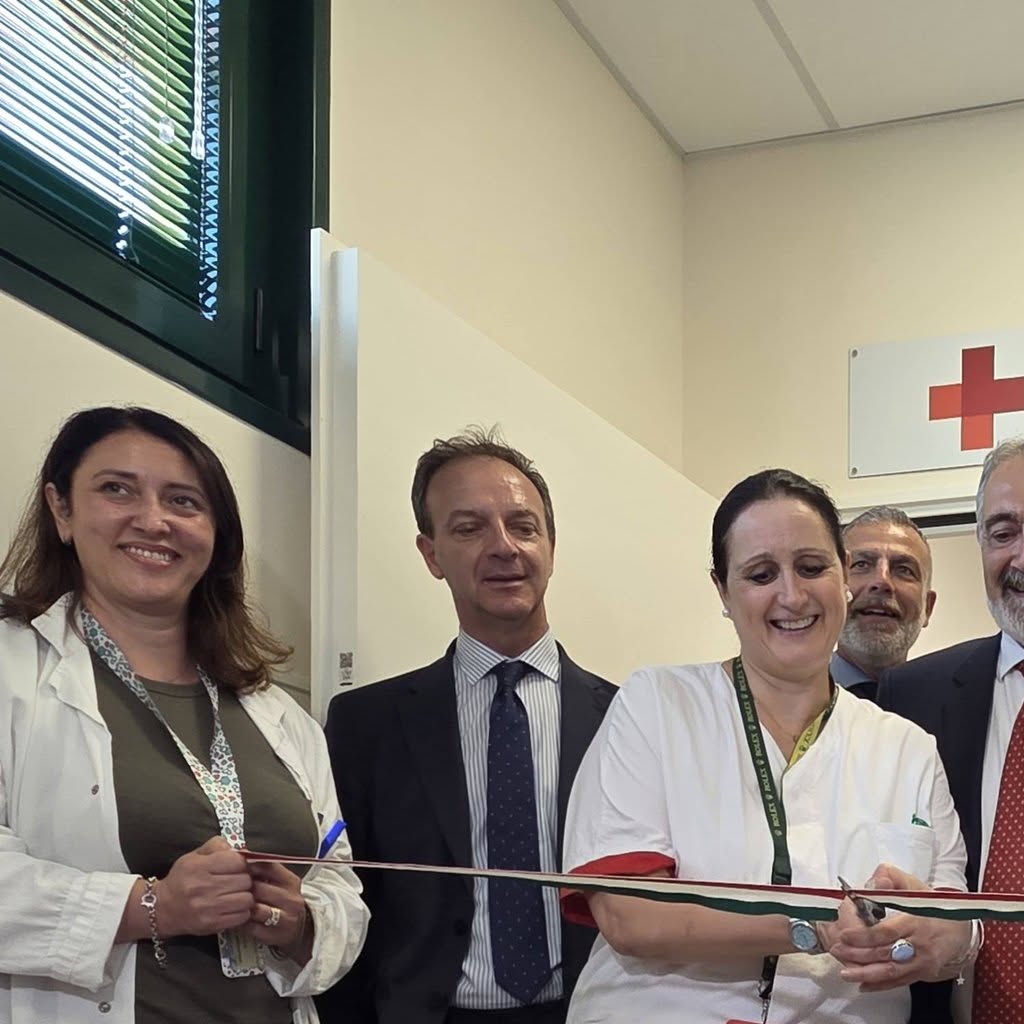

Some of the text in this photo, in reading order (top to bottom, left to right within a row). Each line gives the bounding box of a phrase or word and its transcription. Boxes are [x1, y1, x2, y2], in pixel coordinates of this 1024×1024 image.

[751, 733, 763, 757] ROLEX
[760, 767, 771, 792] ROLEX
[768, 802, 781, 827] ROLEX
